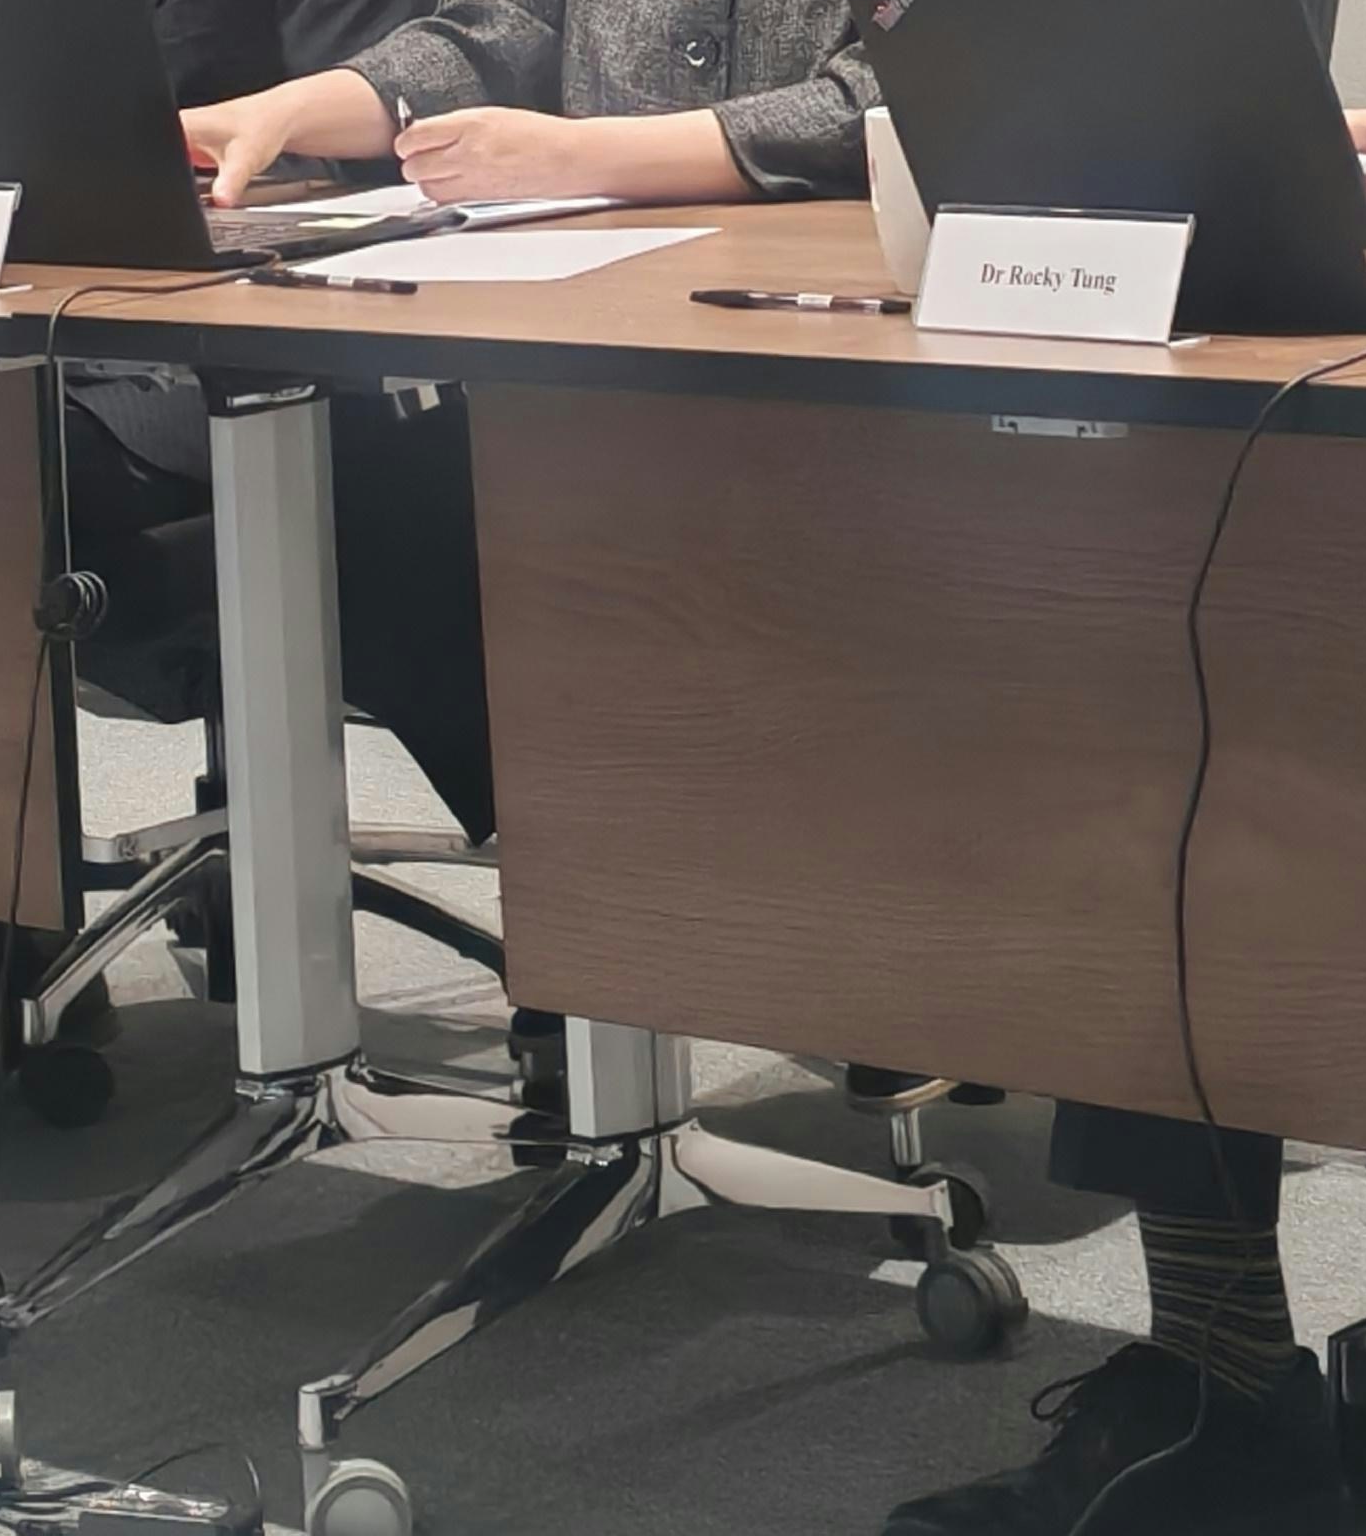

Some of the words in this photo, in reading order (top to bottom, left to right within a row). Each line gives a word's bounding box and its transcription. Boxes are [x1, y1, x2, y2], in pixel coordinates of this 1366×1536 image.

[980, 263, 1005, 284] Dr
[1009, 265, 1064, 292] Rocky
[1071, 267, 1117, 295] Tung
